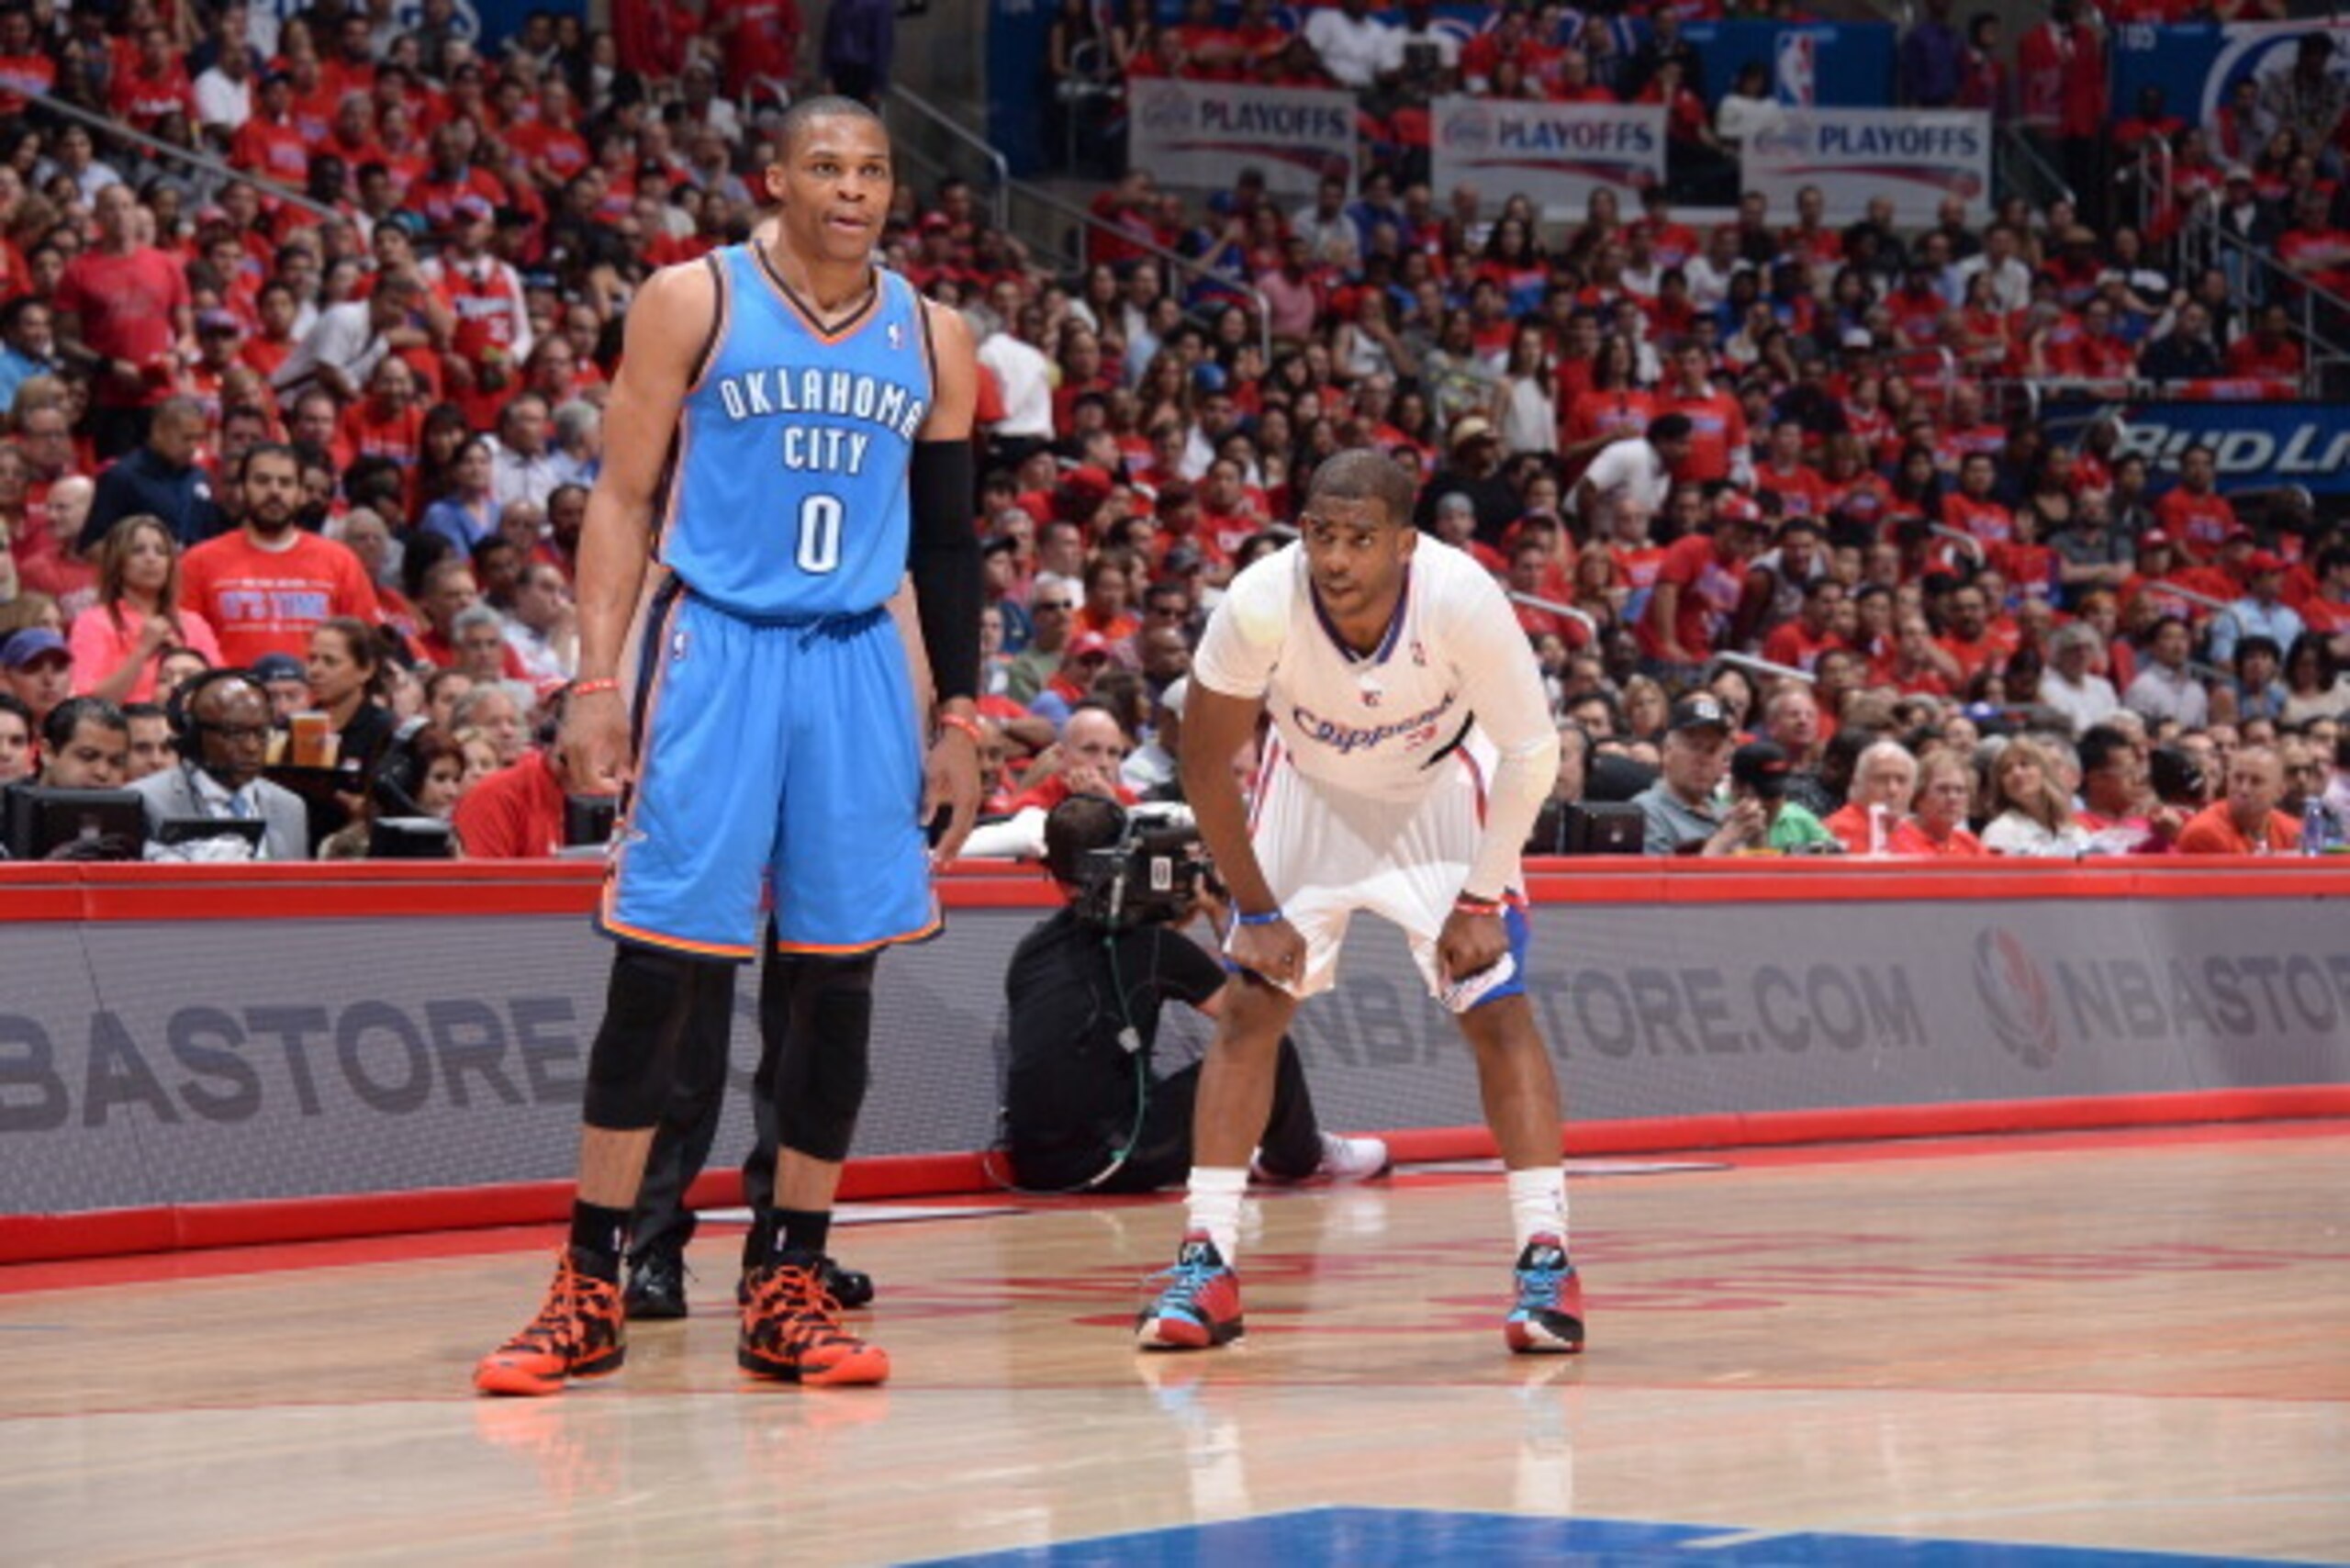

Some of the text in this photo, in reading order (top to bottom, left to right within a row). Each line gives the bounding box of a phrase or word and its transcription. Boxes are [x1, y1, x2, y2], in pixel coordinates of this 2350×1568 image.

[1201, 98, 1348, 139] PLAYOFFS
[1498, 117, 1654, 153] PLAYOFFS
[1818, 123, 1980, 155] PLAYOFFS
[720, 367, 923, 441] OKLAHOMA
[783, 426, 870, 475] CITY
[796, 493, 845, 576] 0
[1290, 961, 1929, 1070] NBTORE.COM
